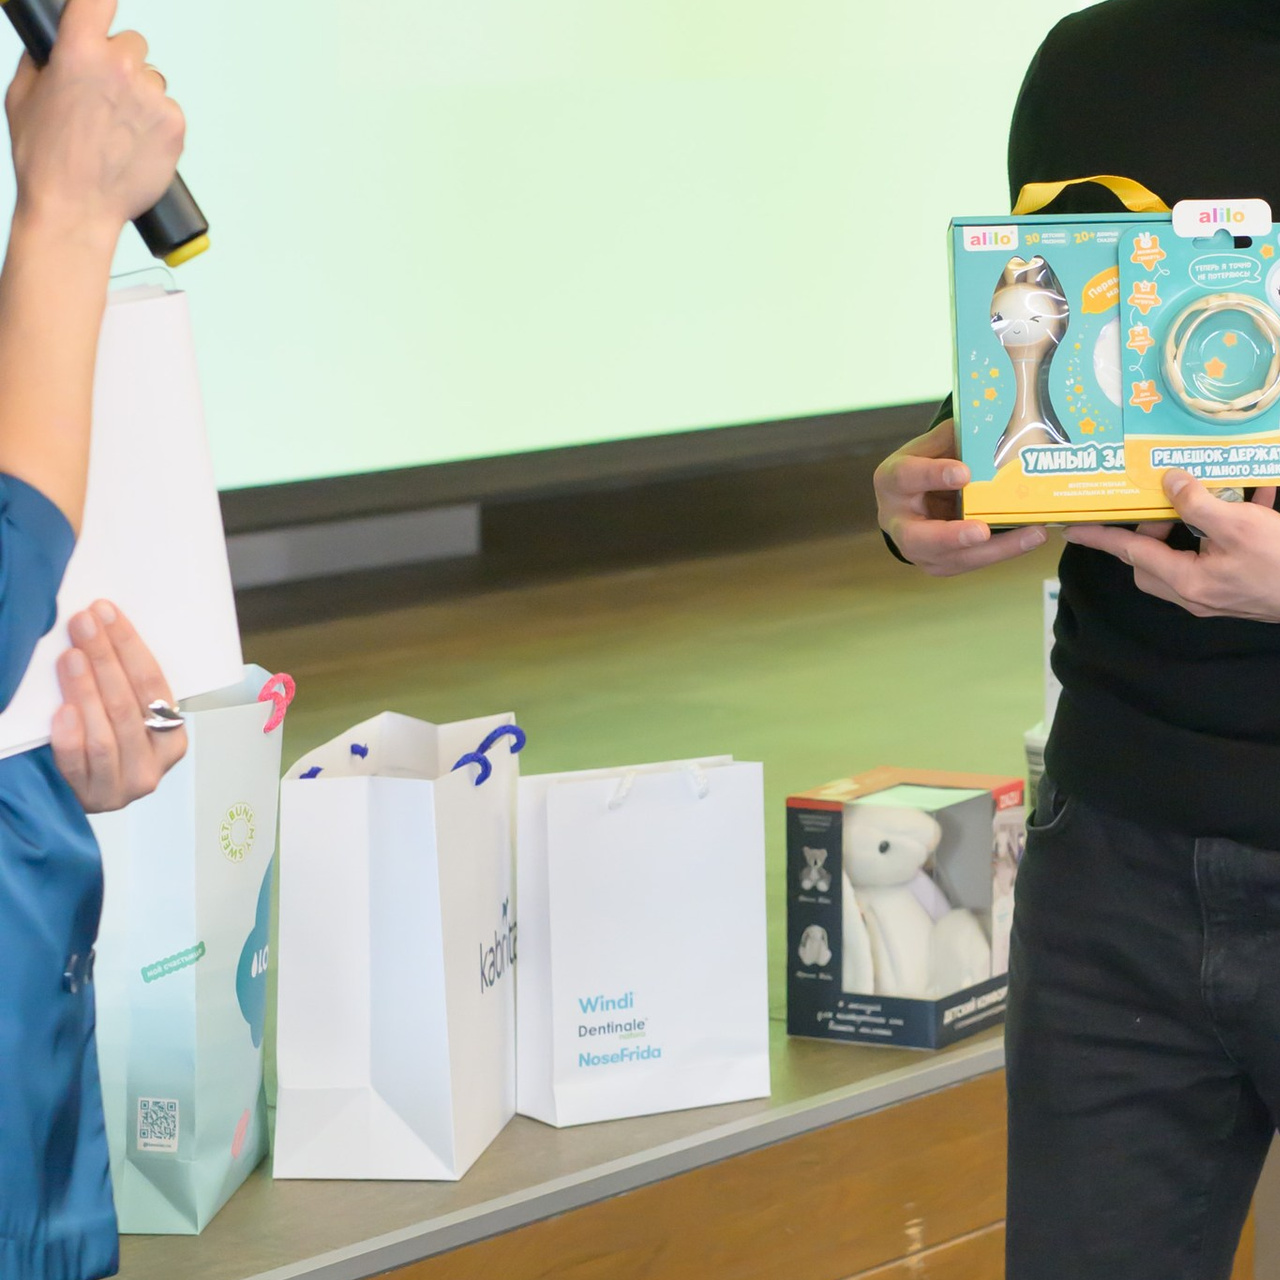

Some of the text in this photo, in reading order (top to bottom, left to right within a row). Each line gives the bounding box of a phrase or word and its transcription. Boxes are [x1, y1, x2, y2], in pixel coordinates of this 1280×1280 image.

[1199, 208, 1245, 223] alilo
[970, 232, 1011, 246] alilo
[1025, 232, 1040, 246] 30
[1024, 447, 1126, 471] УМНЫЙ ЗА
[1205, 464, 1250, 477] УМНОГО
[578, 991, 634, 1014] Windi
[578, 1018, 645, 1038] Dentinale
[578, 1045, 662, 1068] NoseFrida
